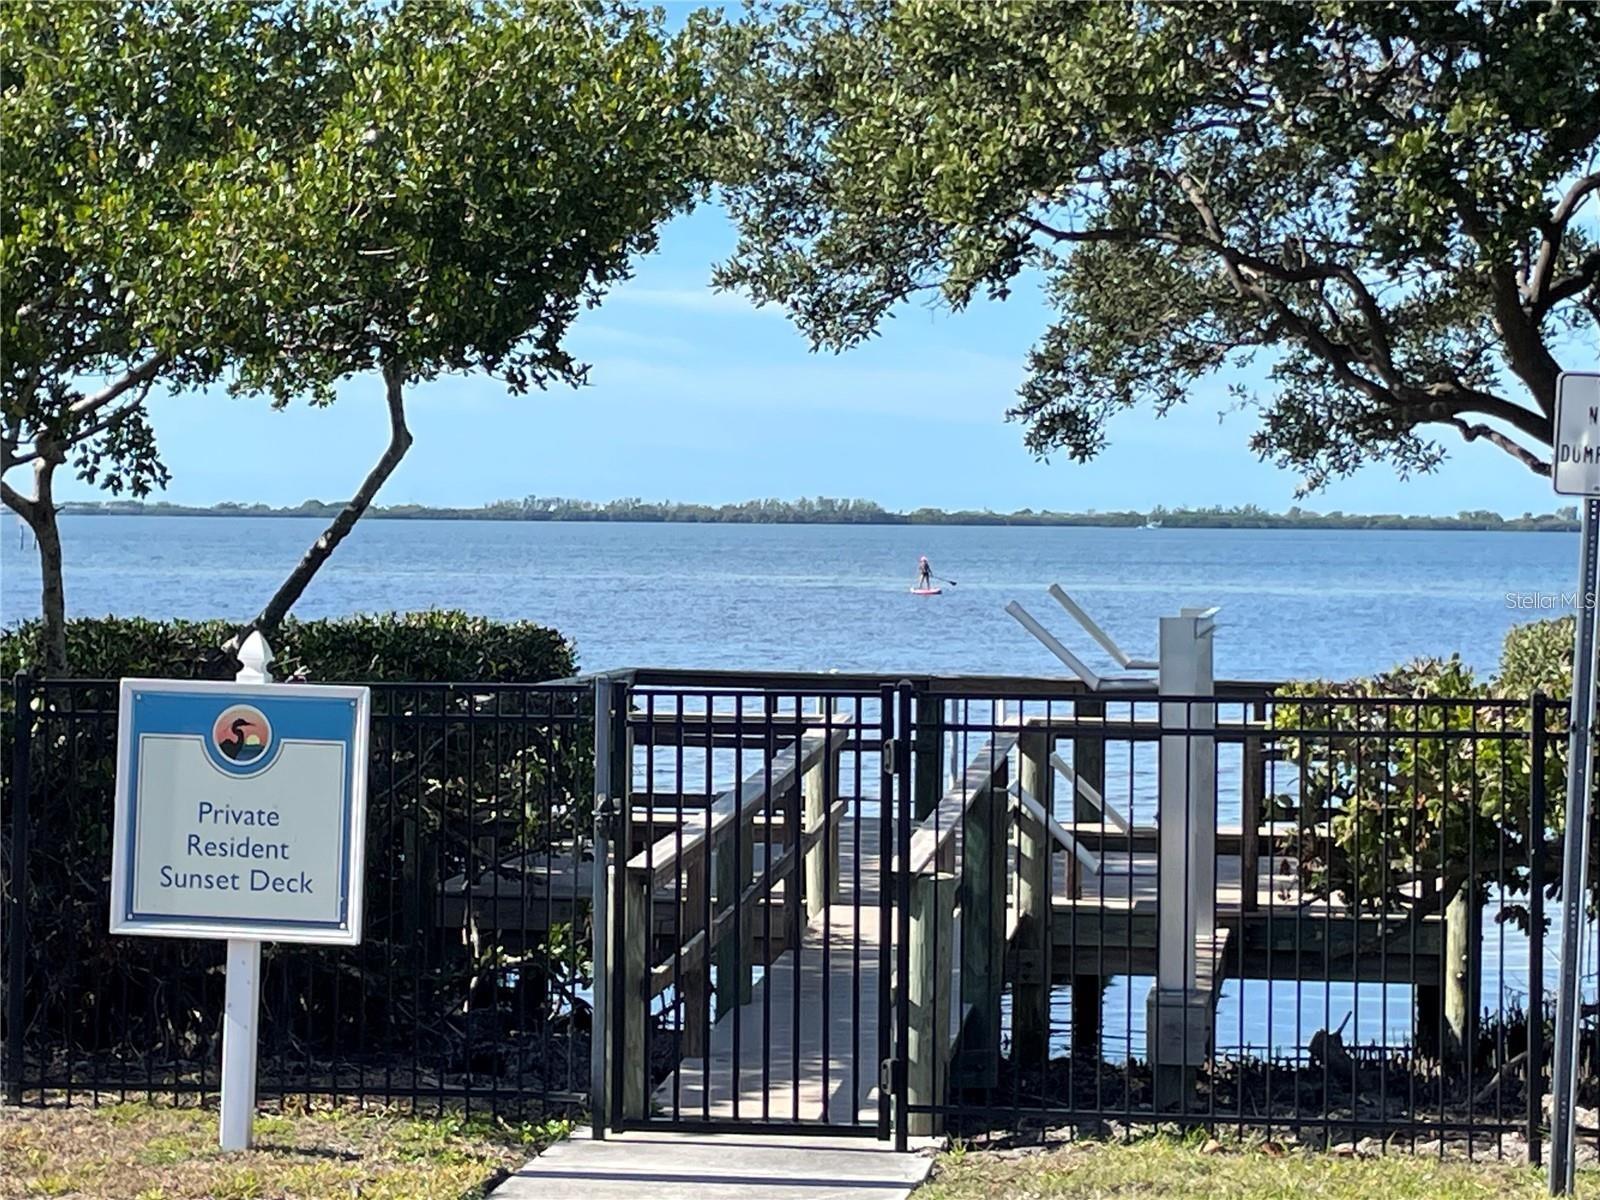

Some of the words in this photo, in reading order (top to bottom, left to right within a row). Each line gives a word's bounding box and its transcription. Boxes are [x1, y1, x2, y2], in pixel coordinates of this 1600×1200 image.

[198, 801, 280, 827] Private
[187, 833, 290, 860] Resident
[160, 865, 240, 891] Sunset
[250, 869, 313, 894] Deck
